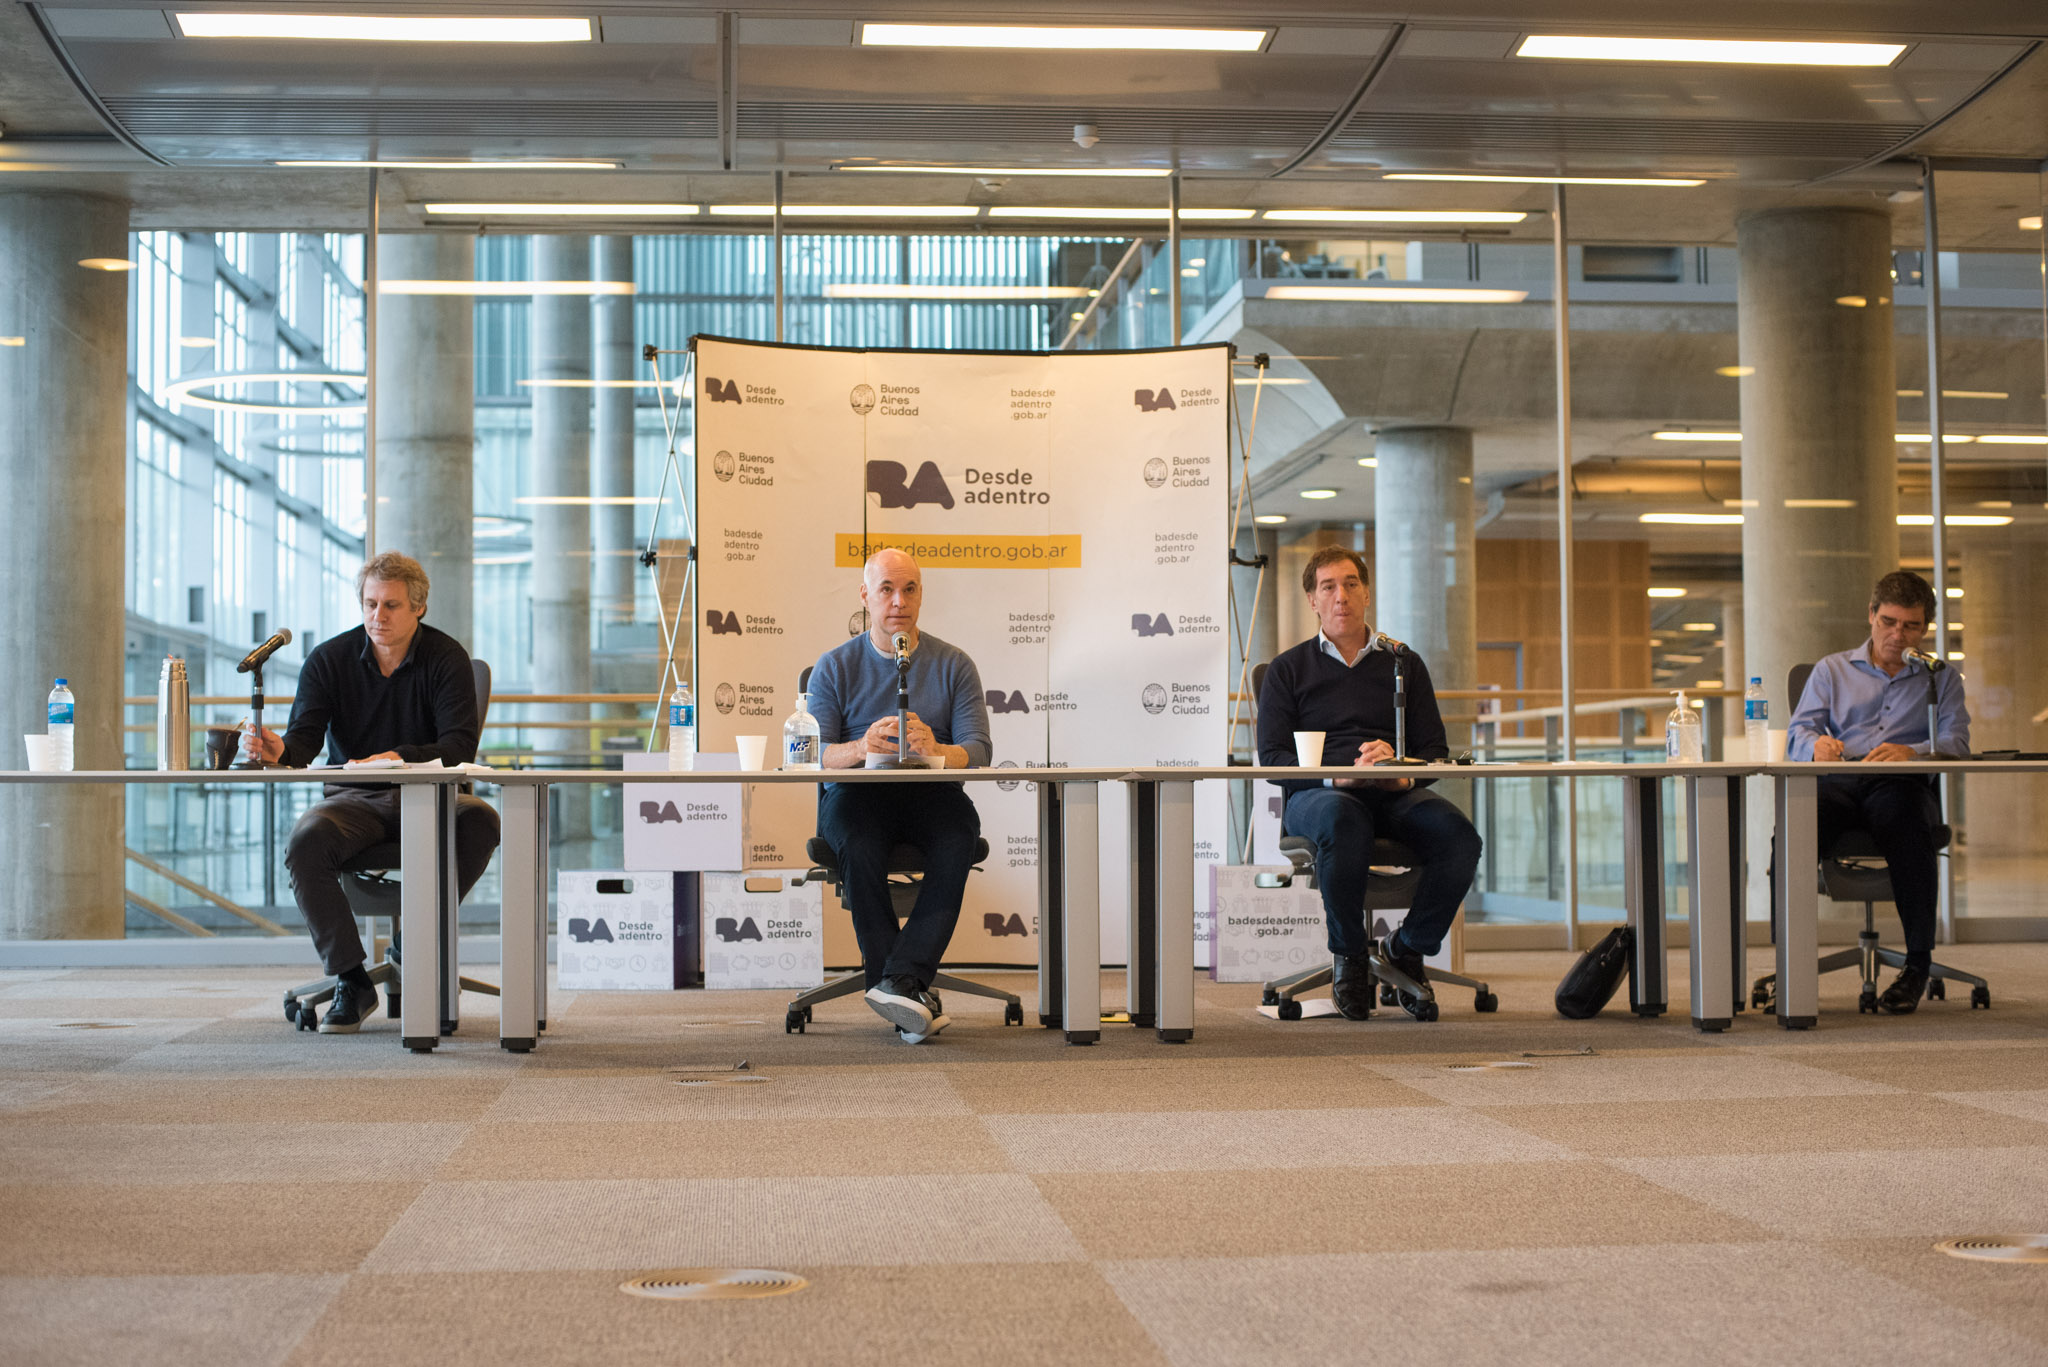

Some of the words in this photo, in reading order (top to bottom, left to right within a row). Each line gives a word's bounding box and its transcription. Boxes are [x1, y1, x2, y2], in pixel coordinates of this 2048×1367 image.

[746, 385, 776, 395] Desde
[881, 384, 920, 394] Buenos
[1011, 389, 1056, 397] badesde
[1181, 388, 1212, 397] Desde
[746, 395, 784, 405] adentro
[880, 396, 909, 405] Aires
[1011, 400, 1052, 409] adentro
[1181, 397, 1219, 407] adentro
[880, 406, 919, 416] Ciudad
[1010, 411, 1047, 420] .gob.ar
[739, 452, 774, 464] Buenos
[1173, 456, 1210, 466] Buenos
[739, 464, 764, 474] Aires
[1172, 467, 1200, 476] Aires
[739, 475, 774, 486] Ciudad
[965, 468, 1032, 485] Desde
[1172, 478, 1209, 487] Ciudad
[964, 488, 1050, 505] adentro
[724, 529, 763, 539] badesde
[1155, 532, 1198, 541] badesde
[724, 541, 759, 550] adentro
[1155, 544, 1194, 552] adentro
[848, 541, 1068, 561] baddeadentro.gob.ar
[724, 552, 755, 562] .gob.ar
[1155, 555, 1190, 565] .gob.ar
[746, 615, 776, 625] Desde
[1009, 613, 1055, 622] badesde
[1179, 615, 1211, 624] Desde
[746, 625, 783, 635] adentro
[1009, 624, 1051, 633] adentro
[1178, 624, 1220, 633] adentro
[1009, 635, 1045, 645] .gob.ar
[740, 684, 774, 694] Buenos
[1172, 683, 1210, 692] Buenos
[739, 695, 764, 705] Aires
[1034, 692, 1069, 702] Desde
[1172, 695, 1200, 703] Aires
[739, 706, 773, 716] Ciudad
[1034, 701, 1077, 711] adentro
[1172, 705, 1209, 715] Ciudad
[1156, 759, 1199, 767] badesde
[687, 803, 719, 811] Desde
[686, 812, 727, 821] adentro
[1007, 836, 1038, 844] bades
[753, 843, 776, 852] esde
[1007, 846, 1037, 855] adent
[752, 853, 784, 862] dentro
[1194, 850, 1219, 859] entro
[1007, 858, 1038, 867] .gob.a
[768, 919, 802, 928] Desde
[1228, 916, 1320, 925] badesdeadentro
[619, 921, 653, 931] Desde
[619, 931, 662, 941] adentro
[767, 929, 811, 939] adentro
[1254, 927, 1294, 937] .gob.ar
